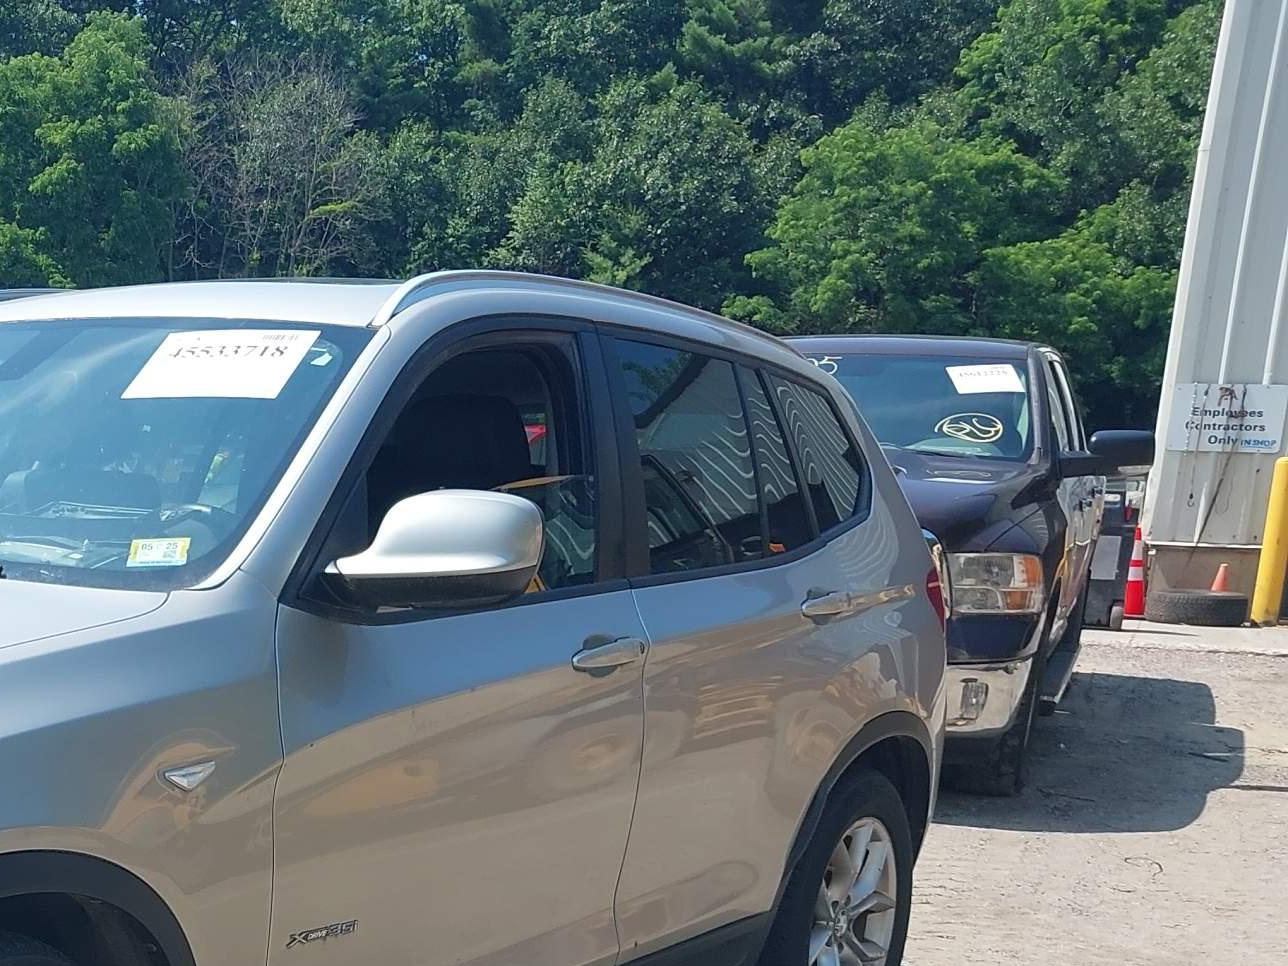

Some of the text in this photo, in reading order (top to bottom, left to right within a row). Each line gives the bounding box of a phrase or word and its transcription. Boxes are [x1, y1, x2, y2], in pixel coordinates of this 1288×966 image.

[168, 344, 289, 358] 45533718
[1192, 407, 1264, 418] Employees
[1185, 420, 1266, 432] Contractors
[1207, 435, 1239, 448] Only
[165, 542, 178, 550] 25
